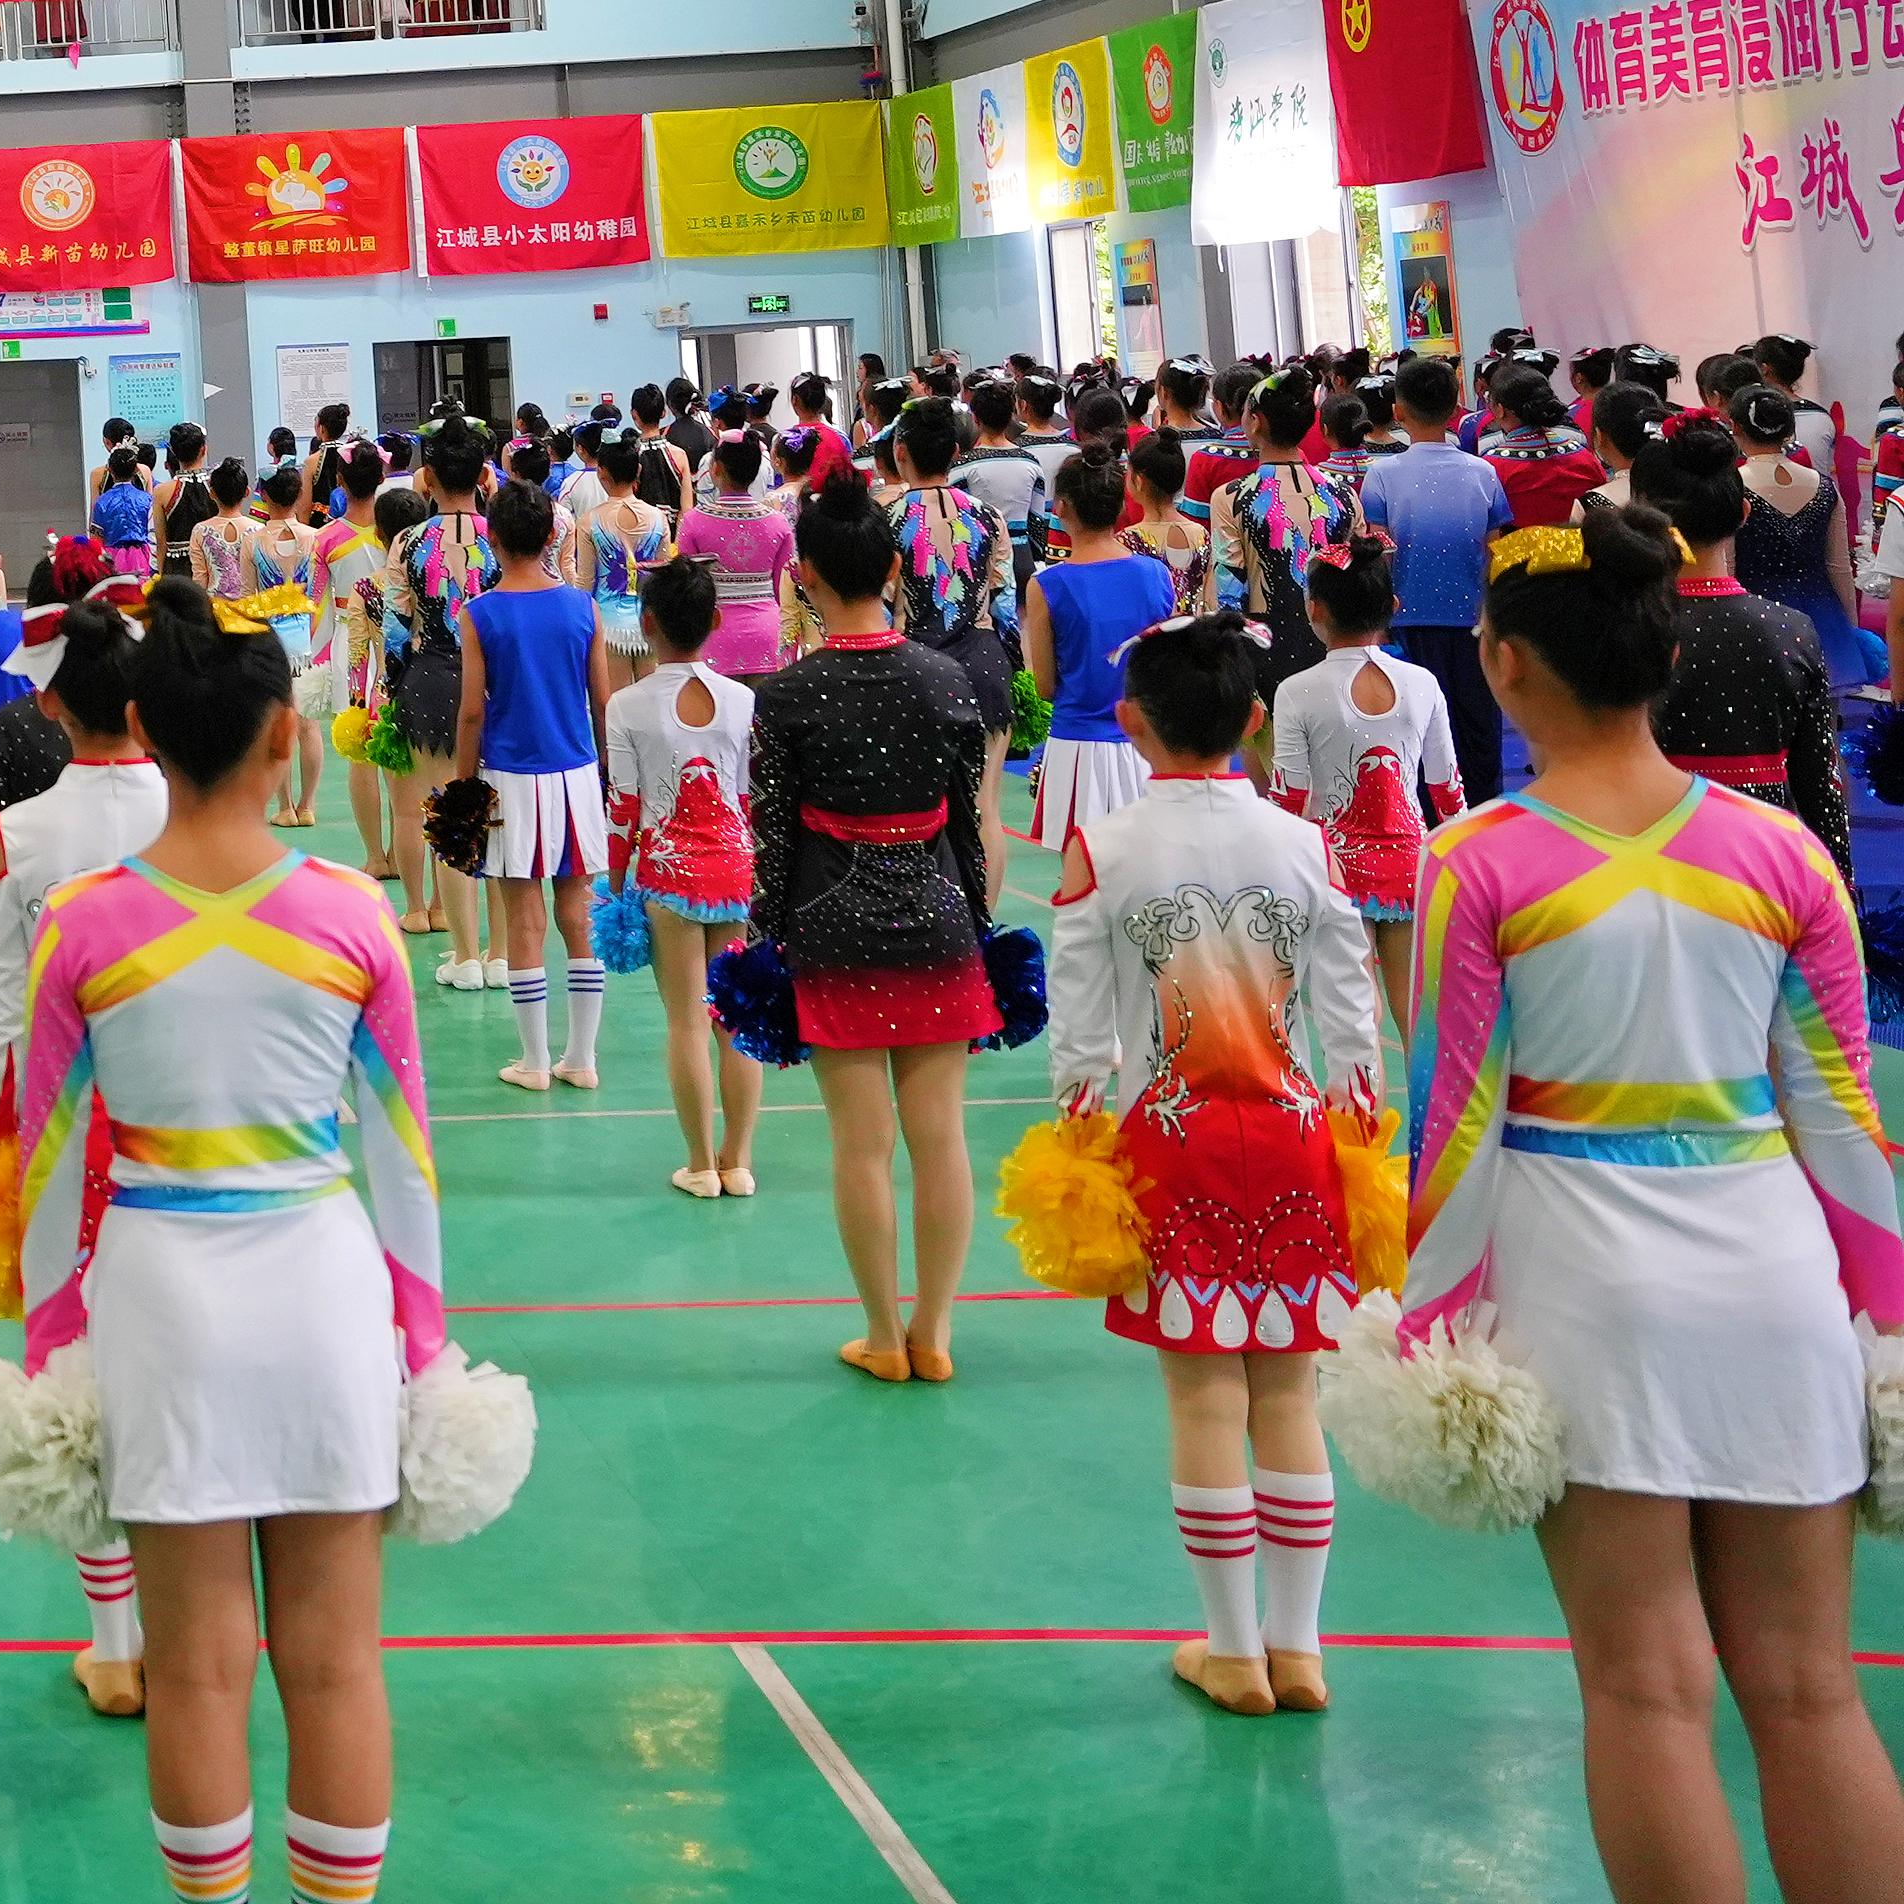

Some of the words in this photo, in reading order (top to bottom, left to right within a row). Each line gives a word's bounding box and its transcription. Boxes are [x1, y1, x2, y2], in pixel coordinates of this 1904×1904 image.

[436, 216, 638, 249] 江城县小太阳幼稚园
[223, 236, 376, 258] 整董镇星萨旺幼儿园
